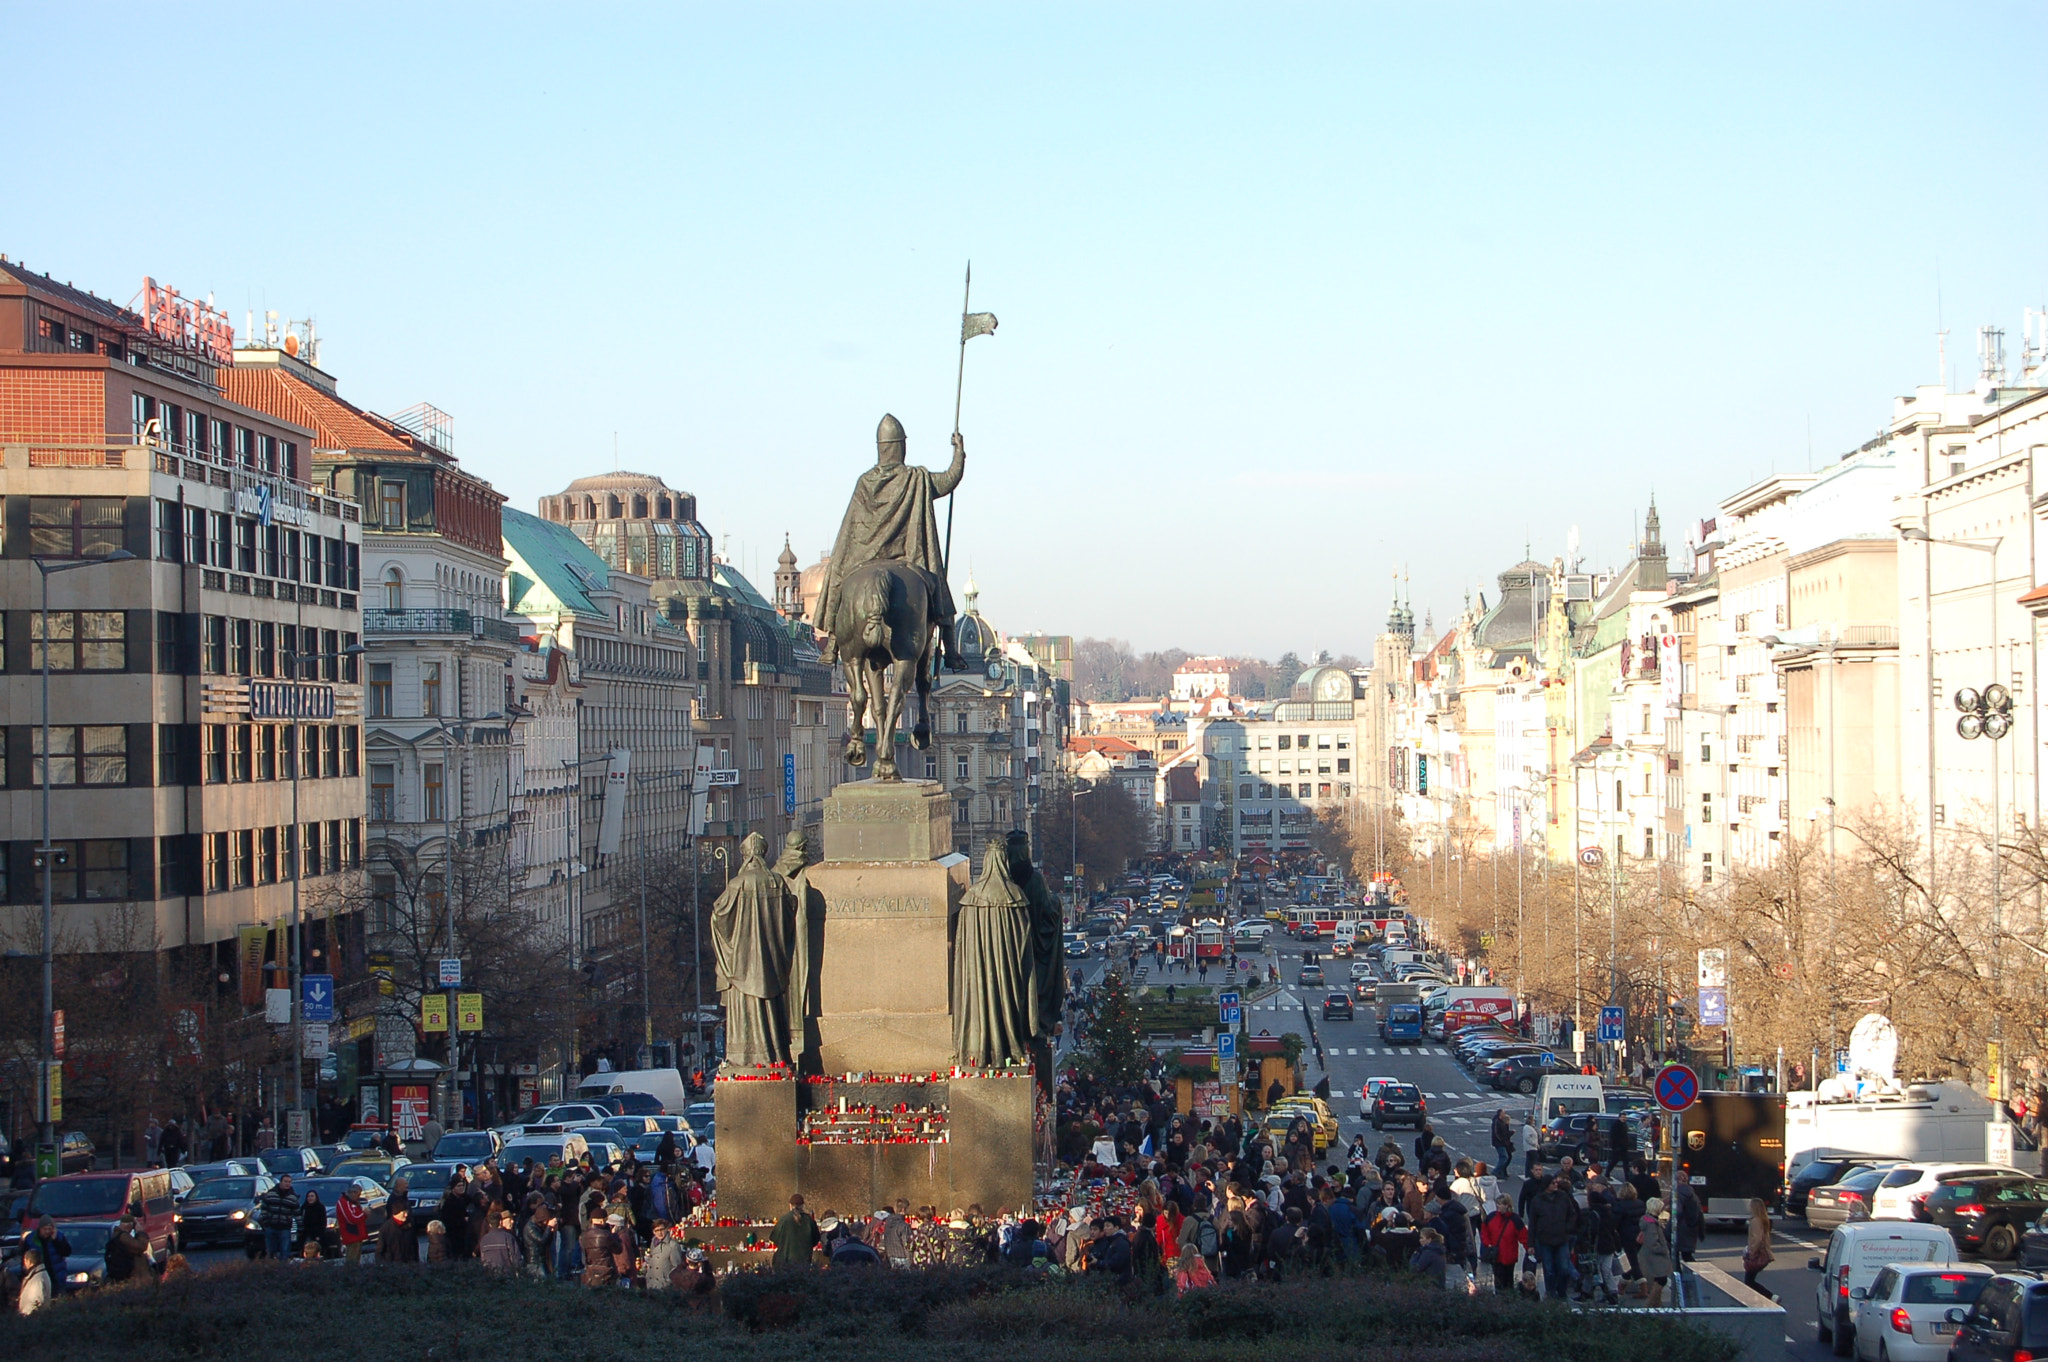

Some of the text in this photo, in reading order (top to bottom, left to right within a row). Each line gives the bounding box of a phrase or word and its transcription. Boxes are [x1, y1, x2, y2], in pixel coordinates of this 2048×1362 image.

[254, 684, 331, 716] STROJEXPORT
[785, 757, 795, 813] ROKOKO
[1230, 1009, 1238, 1018] P
[1221, 1036, 1231, 1052] P
